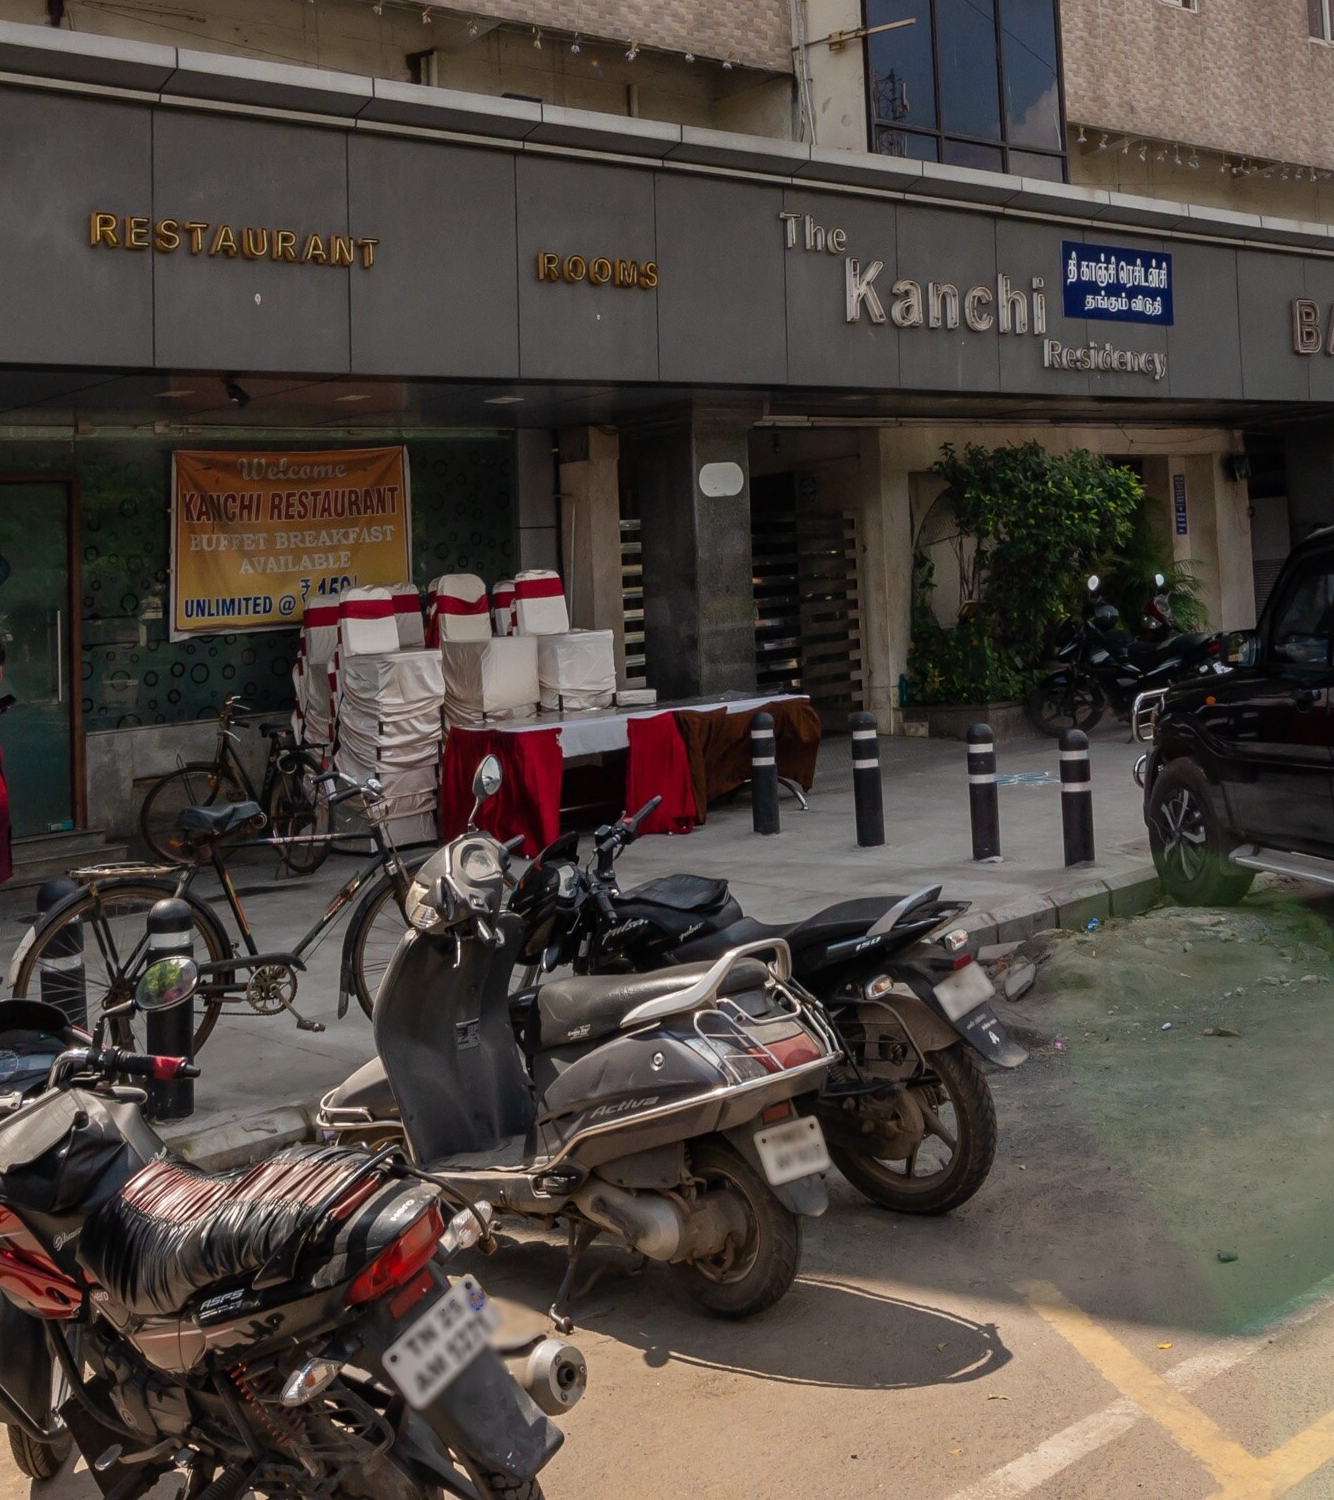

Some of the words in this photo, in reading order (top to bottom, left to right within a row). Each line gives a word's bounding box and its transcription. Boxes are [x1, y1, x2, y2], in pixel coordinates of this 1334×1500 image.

[89, 211, 380, 270] RESTAURANT
[779, 211, 847, 255] The
[536, 251, 660, 290] ROOMS
[1067, 250, 1077, 286] தி
[1080, 253, 1116, 287] காஞ்சி
[1118, 258, 1168, 289] ரெசிடன்சி
[845, 257, 1046, 336] Kanchi
[1085, 290, 1129, 312] தங்கும்
[1131, 295, 1162, 316] விடுதி
[1043, 338, 1168, 381] Residency
[237, 457, 347, 481] Welcome
[183, 492, 263, 523] KANCHI
[269, 486, 399, 522] RESTAURANT
[190, 533, 268, 551] BUFFET
[275, 525, 395, 549] BREAKFAST
[239, 551, 351, 575] AVAILABLE
[184, 596, 273, 618] UNLIMITED
[278, 595, 296, 616] @
[589, 1096, 660, 1119] Activa
